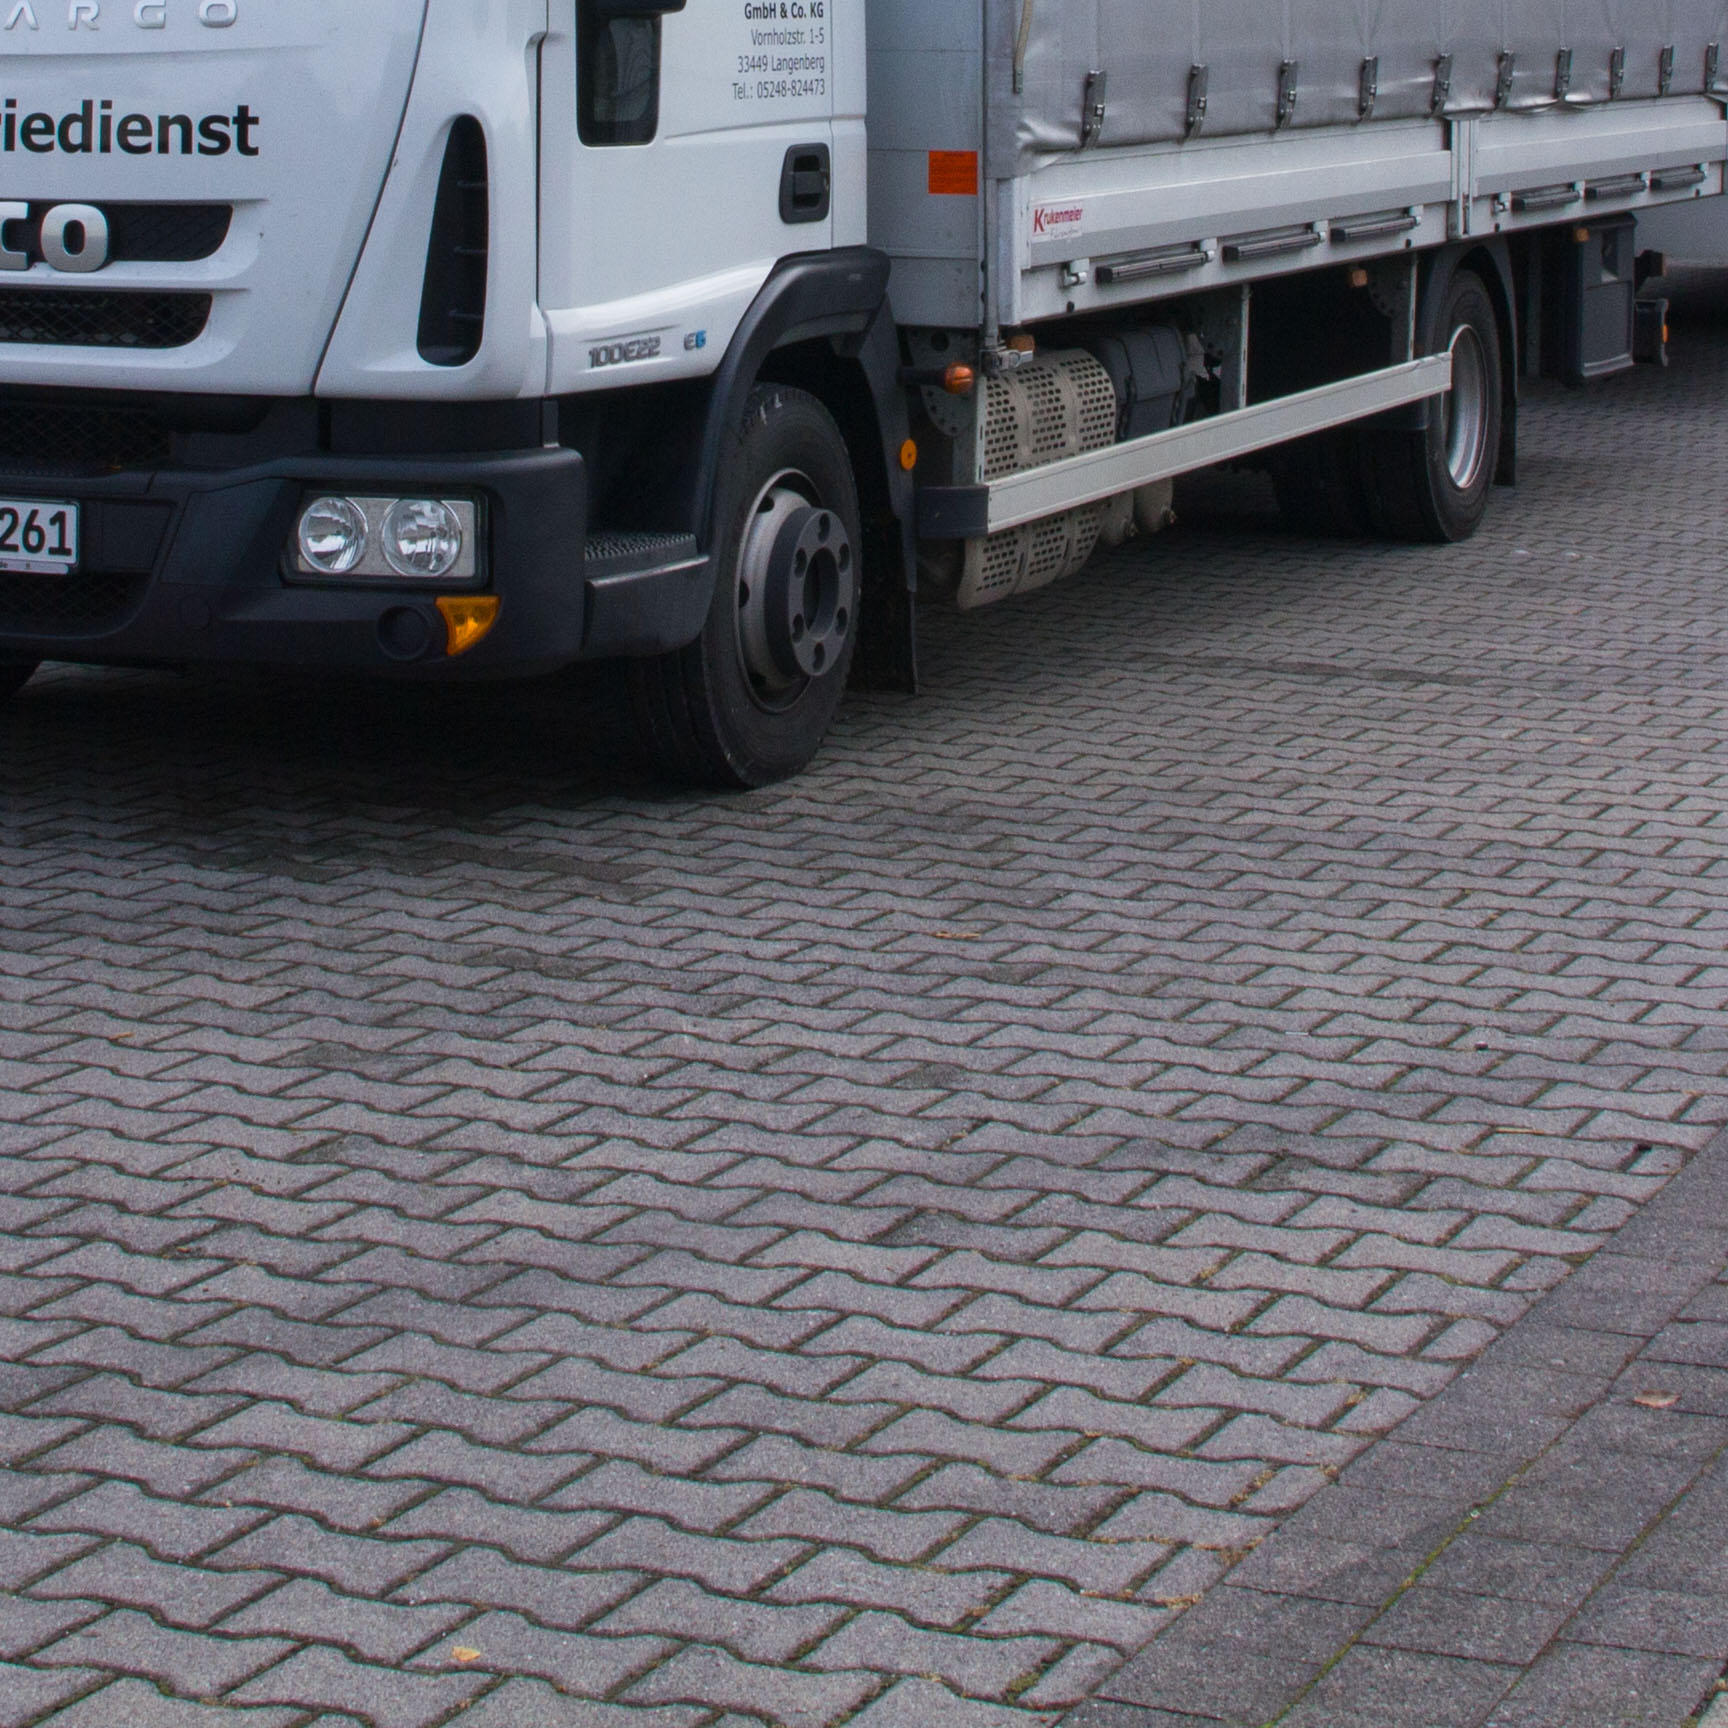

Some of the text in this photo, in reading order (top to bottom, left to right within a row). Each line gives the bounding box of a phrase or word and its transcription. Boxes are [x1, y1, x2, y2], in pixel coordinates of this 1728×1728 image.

[744, 1, 824, 19] GmbH & Co. KG
[751, 27, 824, 46] Vornholzstr. 1-5
[737, 53, 825, 75] 33449 Langenberg
[757, 78, 825, 99] 05248-824473
[588, 336, 661, 369] 100E22
